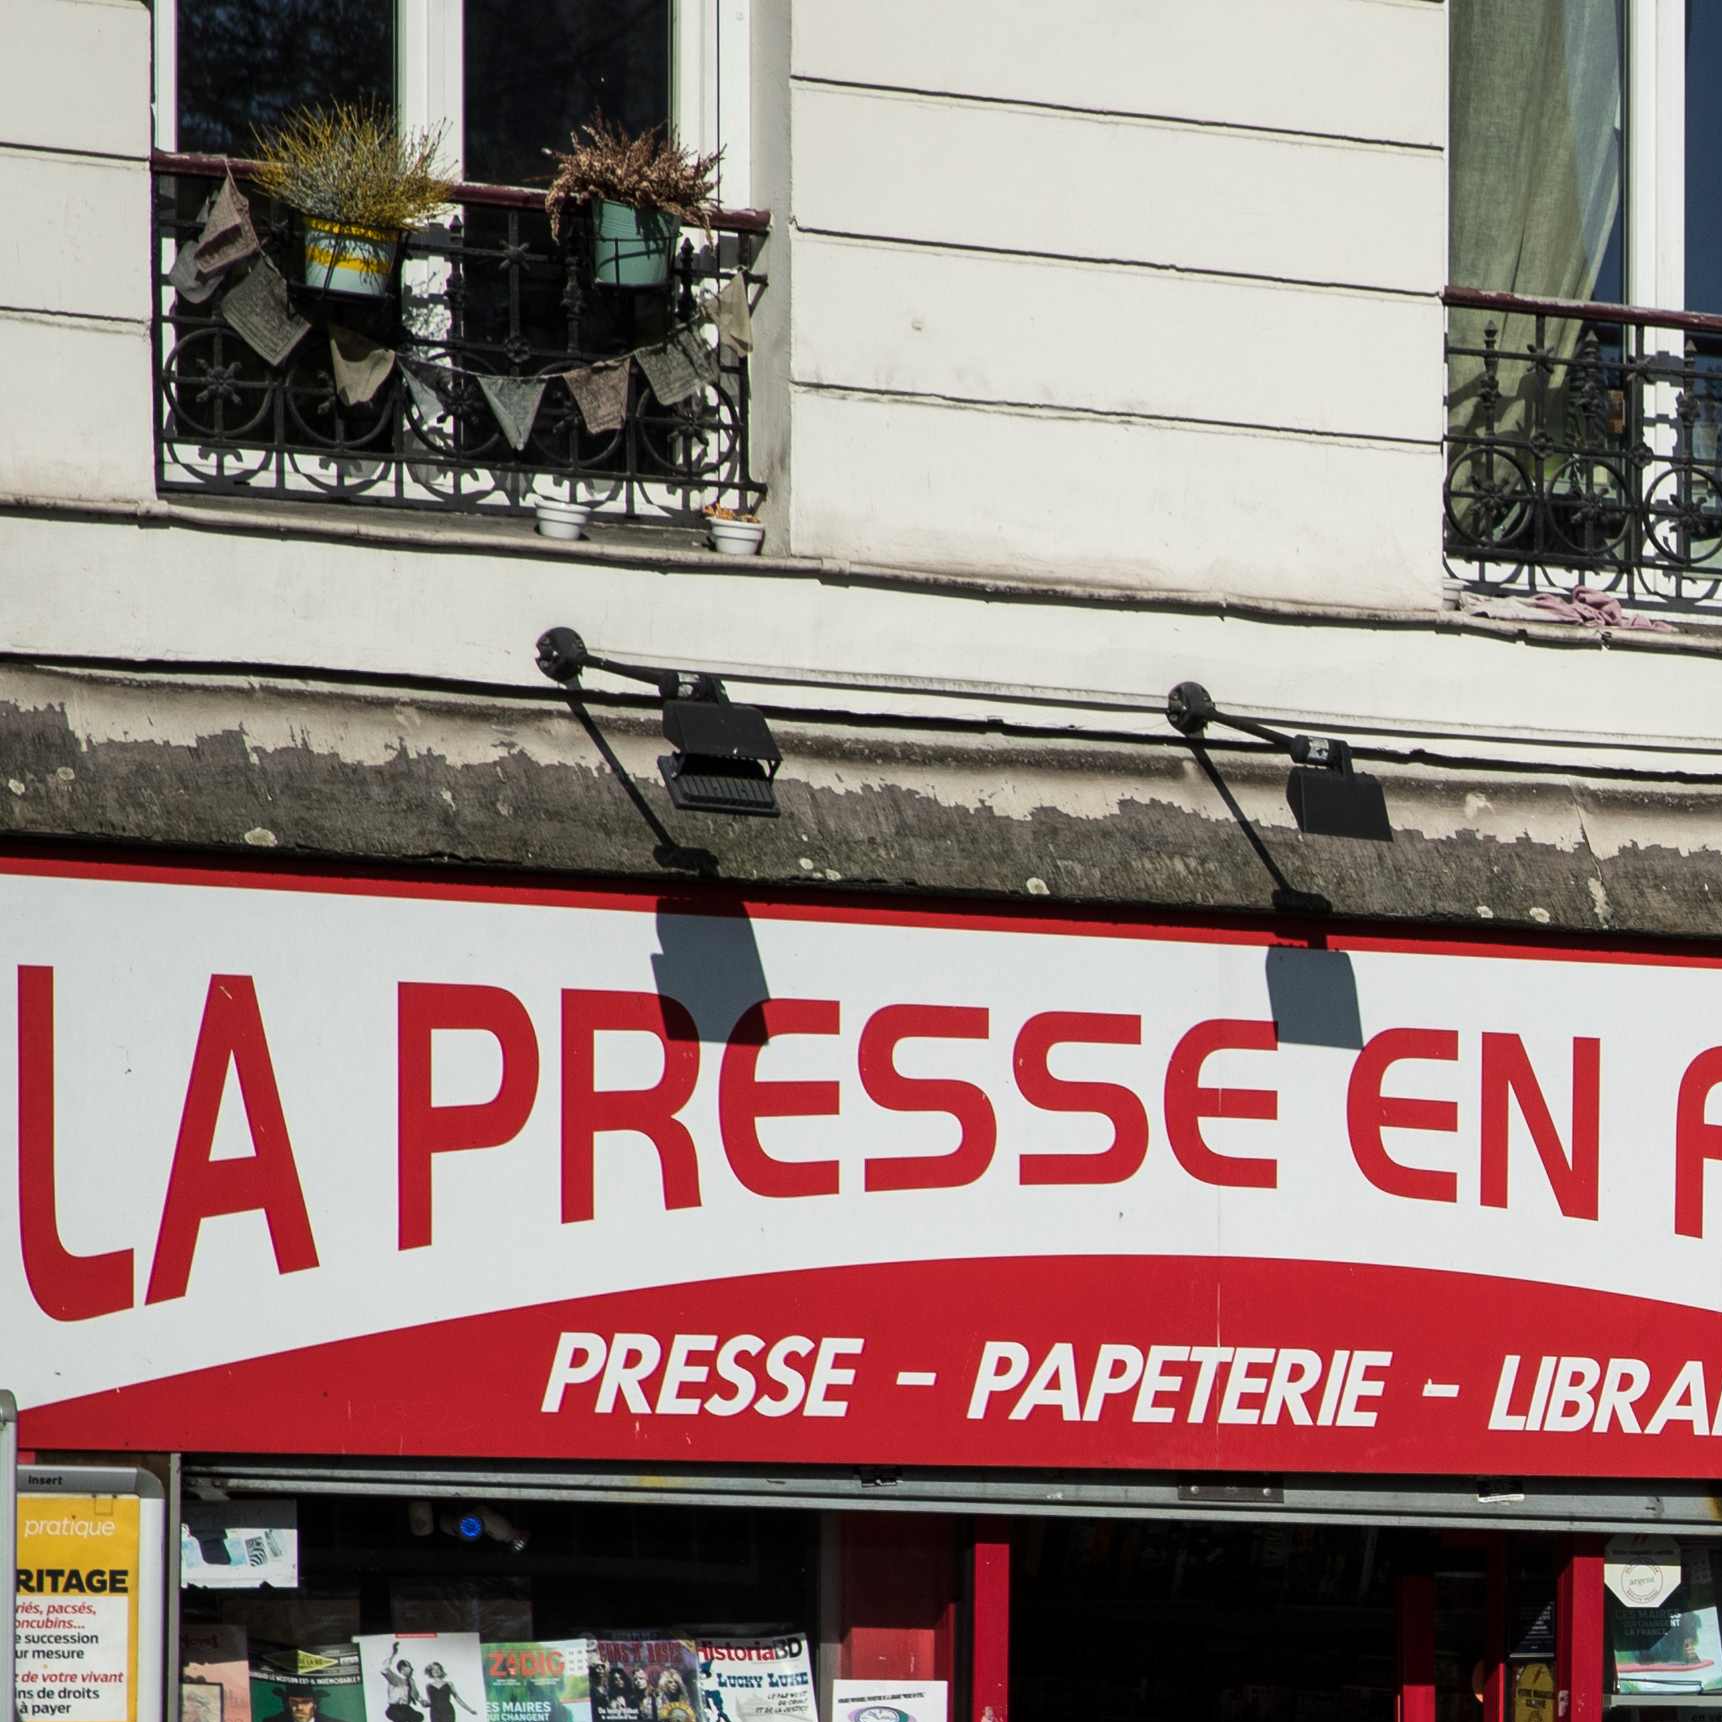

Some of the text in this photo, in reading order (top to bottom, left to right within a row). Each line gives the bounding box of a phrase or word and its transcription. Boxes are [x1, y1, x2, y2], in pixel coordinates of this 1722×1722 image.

[18, 965, 320, 1322] LA
[398, 981, 1277, 1251] PRESSE
[1346, 1027, 1600, 1221] EN
[541, 1332, 865, 1418] PRESSE
[896, 1372, 936, 1387] -
[967, 1341, 1393, 1427] PAPETERIE
[1423, 1380, 1460, 1398] -
[24, 1515, 117, 1538] pratique
[16, 1569, 129, 1594] RITAGE
[25, 1632, 99, 1645] succession
[488, 1648, 566, 1679] ZADIG
[21, 1671, 124, 1683] de votre vivant
[716, 1671, 809, 1689] LUCKY LUKE
[37, 1687, 100, 1700] de droits
[484, 1701, 552, 1713] ES MAIRES
[501, 1712, 550, 1722] CHANGENT
